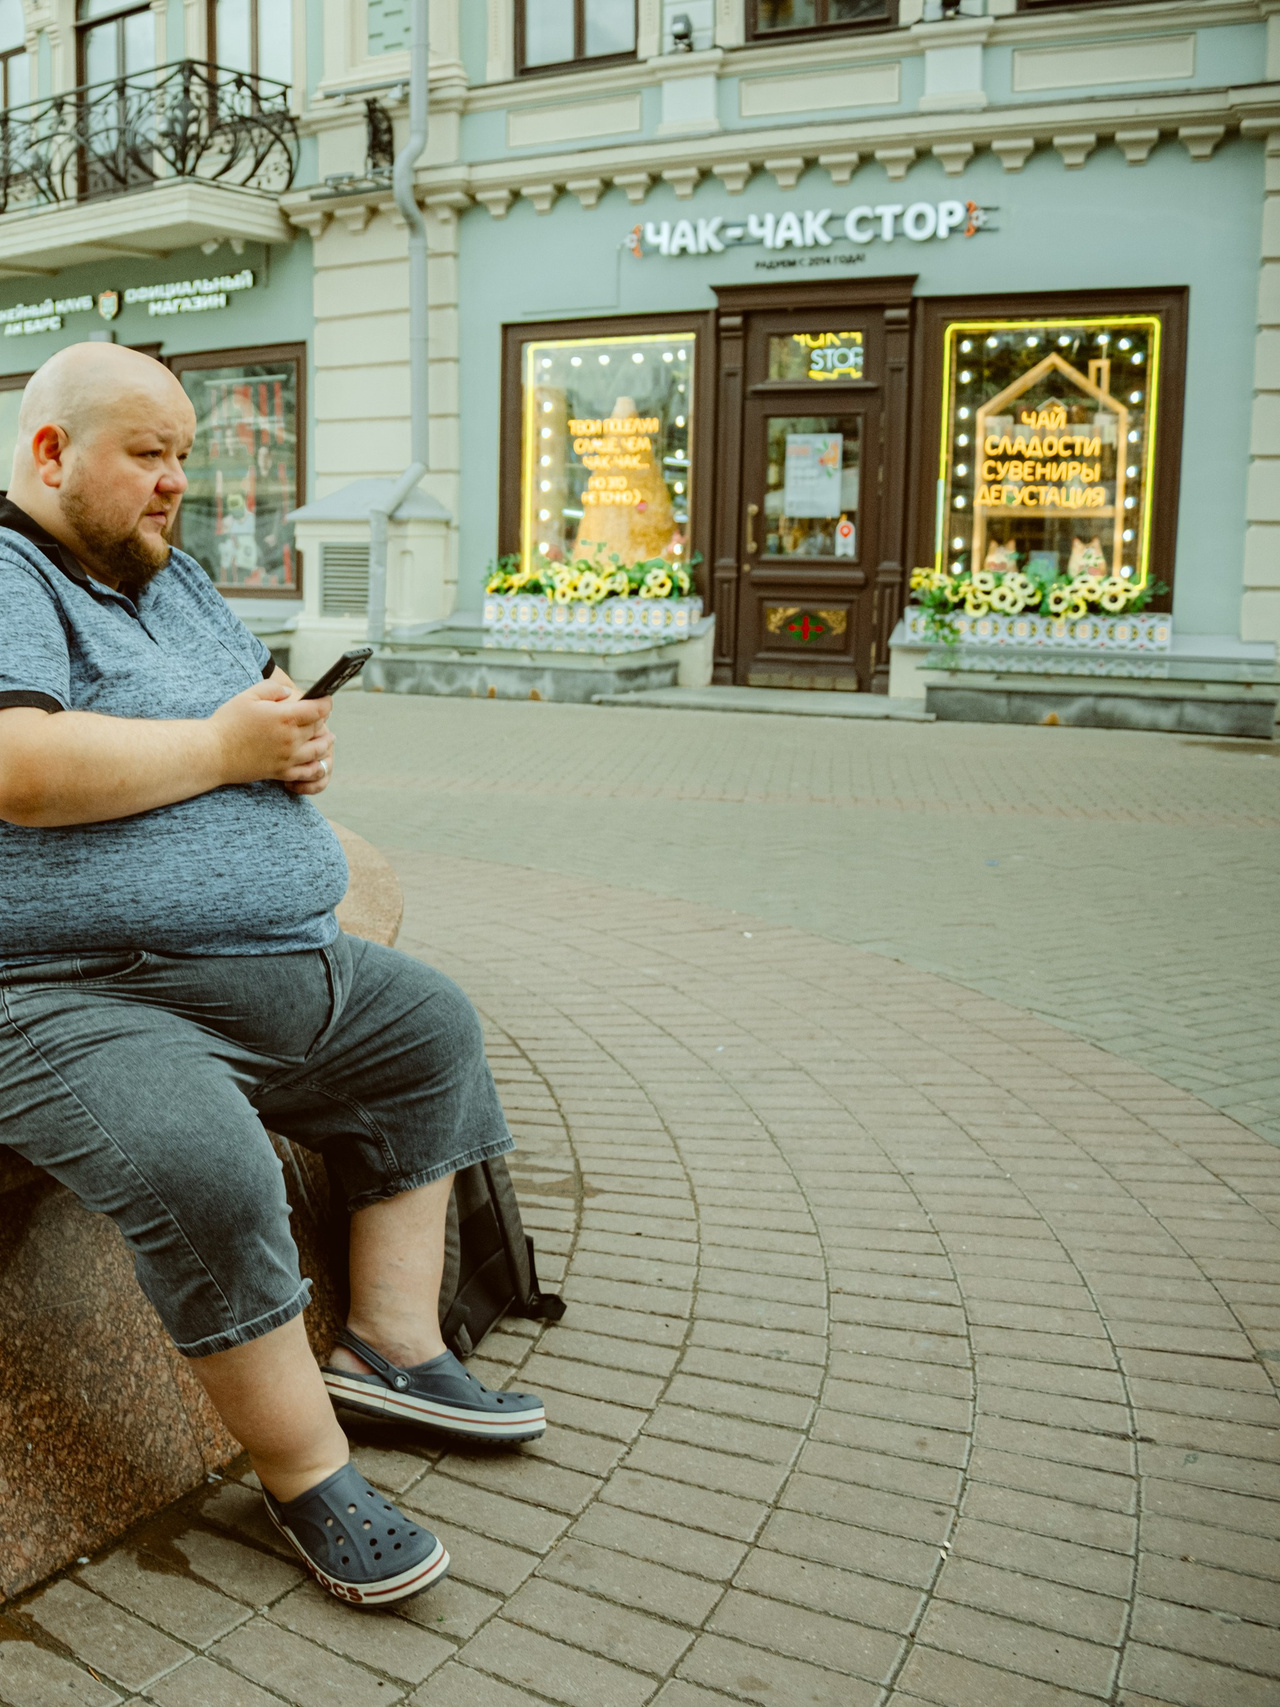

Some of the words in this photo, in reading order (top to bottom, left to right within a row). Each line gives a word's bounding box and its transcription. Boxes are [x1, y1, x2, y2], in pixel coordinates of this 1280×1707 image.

[644, 208, 832, 255] ЧАК-ЧАК
[844, 200, 966, 244] СТОР
[124, 269, 254, 304] ОФИЦИАЛЬНЫЙ
[148, 293, 227, 316] МАГАЗИН
[23, 315, 62, 335] БАРС
[1021, 406, 1068, 430] ЧАЙ
[984, 435, 1102, 458] СЛАДОСТИ
[981, 460, 1102, 483] СУВЕНИРЫ
[973, 484, 1106, 508] ДЕГУСТАЦИЯ
